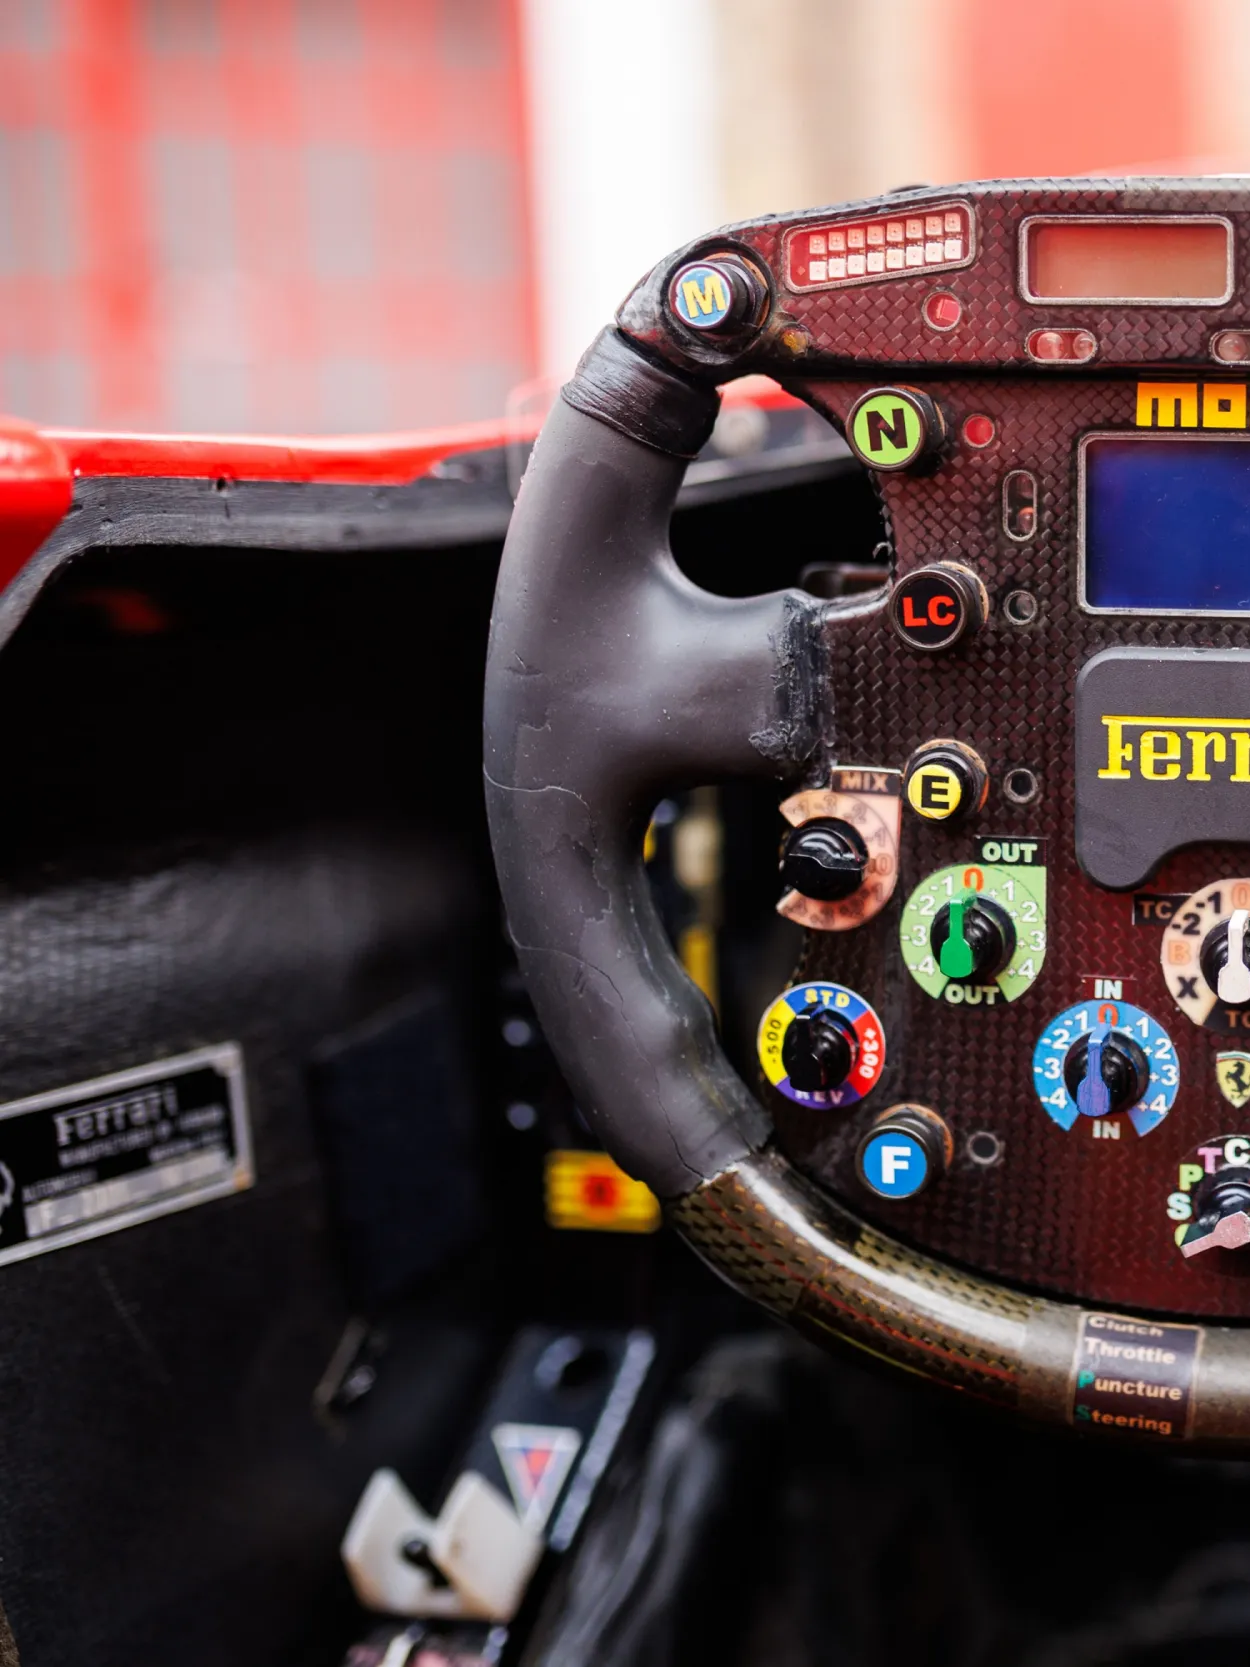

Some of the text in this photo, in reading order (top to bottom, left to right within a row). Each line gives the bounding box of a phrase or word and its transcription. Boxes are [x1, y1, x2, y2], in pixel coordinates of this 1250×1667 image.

[682, 274, 726, 319] M
[865, 407, 905, 452] N
[902, 595, 956, 627] LC
[840, 771, 889, 792] MIX
[920, 774, 950, 810] E
[982, 841, 1038, 863] OUT
[930, 875, 954, 896] -1
[989, 880, 1015, 902] +1
[909, 894, 935, 916] -2
[1009, 901, 1038, 923] +2
[1139, 901, 1173, 919] TC
[1195, 891, 1222, 914] -1
[1172, 913, 1201, 936] -2
[901, 925, 927, 947] -3
[1016, 930, 1046, 952] +3
[1168, 940, 1191, 966] B
[908, 955, 935, 976] -4
[1007, 958, 1036, 980] +4
[804, 988, 850, 1008] STD
[944, 984, 1000, 1005] OUT
[1094, 979, 1123, 1000] IN
[1176, 976, 1199, 1000] X
[1063, 1010, 1088, 1032] -1
[1122, 1017, 1149, 1038] +1
[767, 1019, 781, 1064] -500
[1041, 1029, 1070, 1050] -2
[1143, 1038, 1172, 1061] +2
[859, 1028, 879, 1079] +300
[1034, 1057, 1061, 1080] -3
[1148, 1064, 1178, 1086] +3
[1040, 1087, 1068, 1110] -4
[1137, 1093, 1168, 1115] +4
[1092, 1120, 1121, 1140] IN
[1198, 1147, 1223, 1174] T
[1224, 1138, 1250, 1166] C
[881, 1145, 911, 1184] F
[1179, 1164, 1204, 1191] P
[1167, 1192, 1192, 1220] S
[1088, 1316, 1164, 1337] Clutch
[1084, 1337, 1176, 1365] Throttle
[1078, 1369, 1183, 1401] Puncture
[1075, 1404, 1172, 1435] Steering
